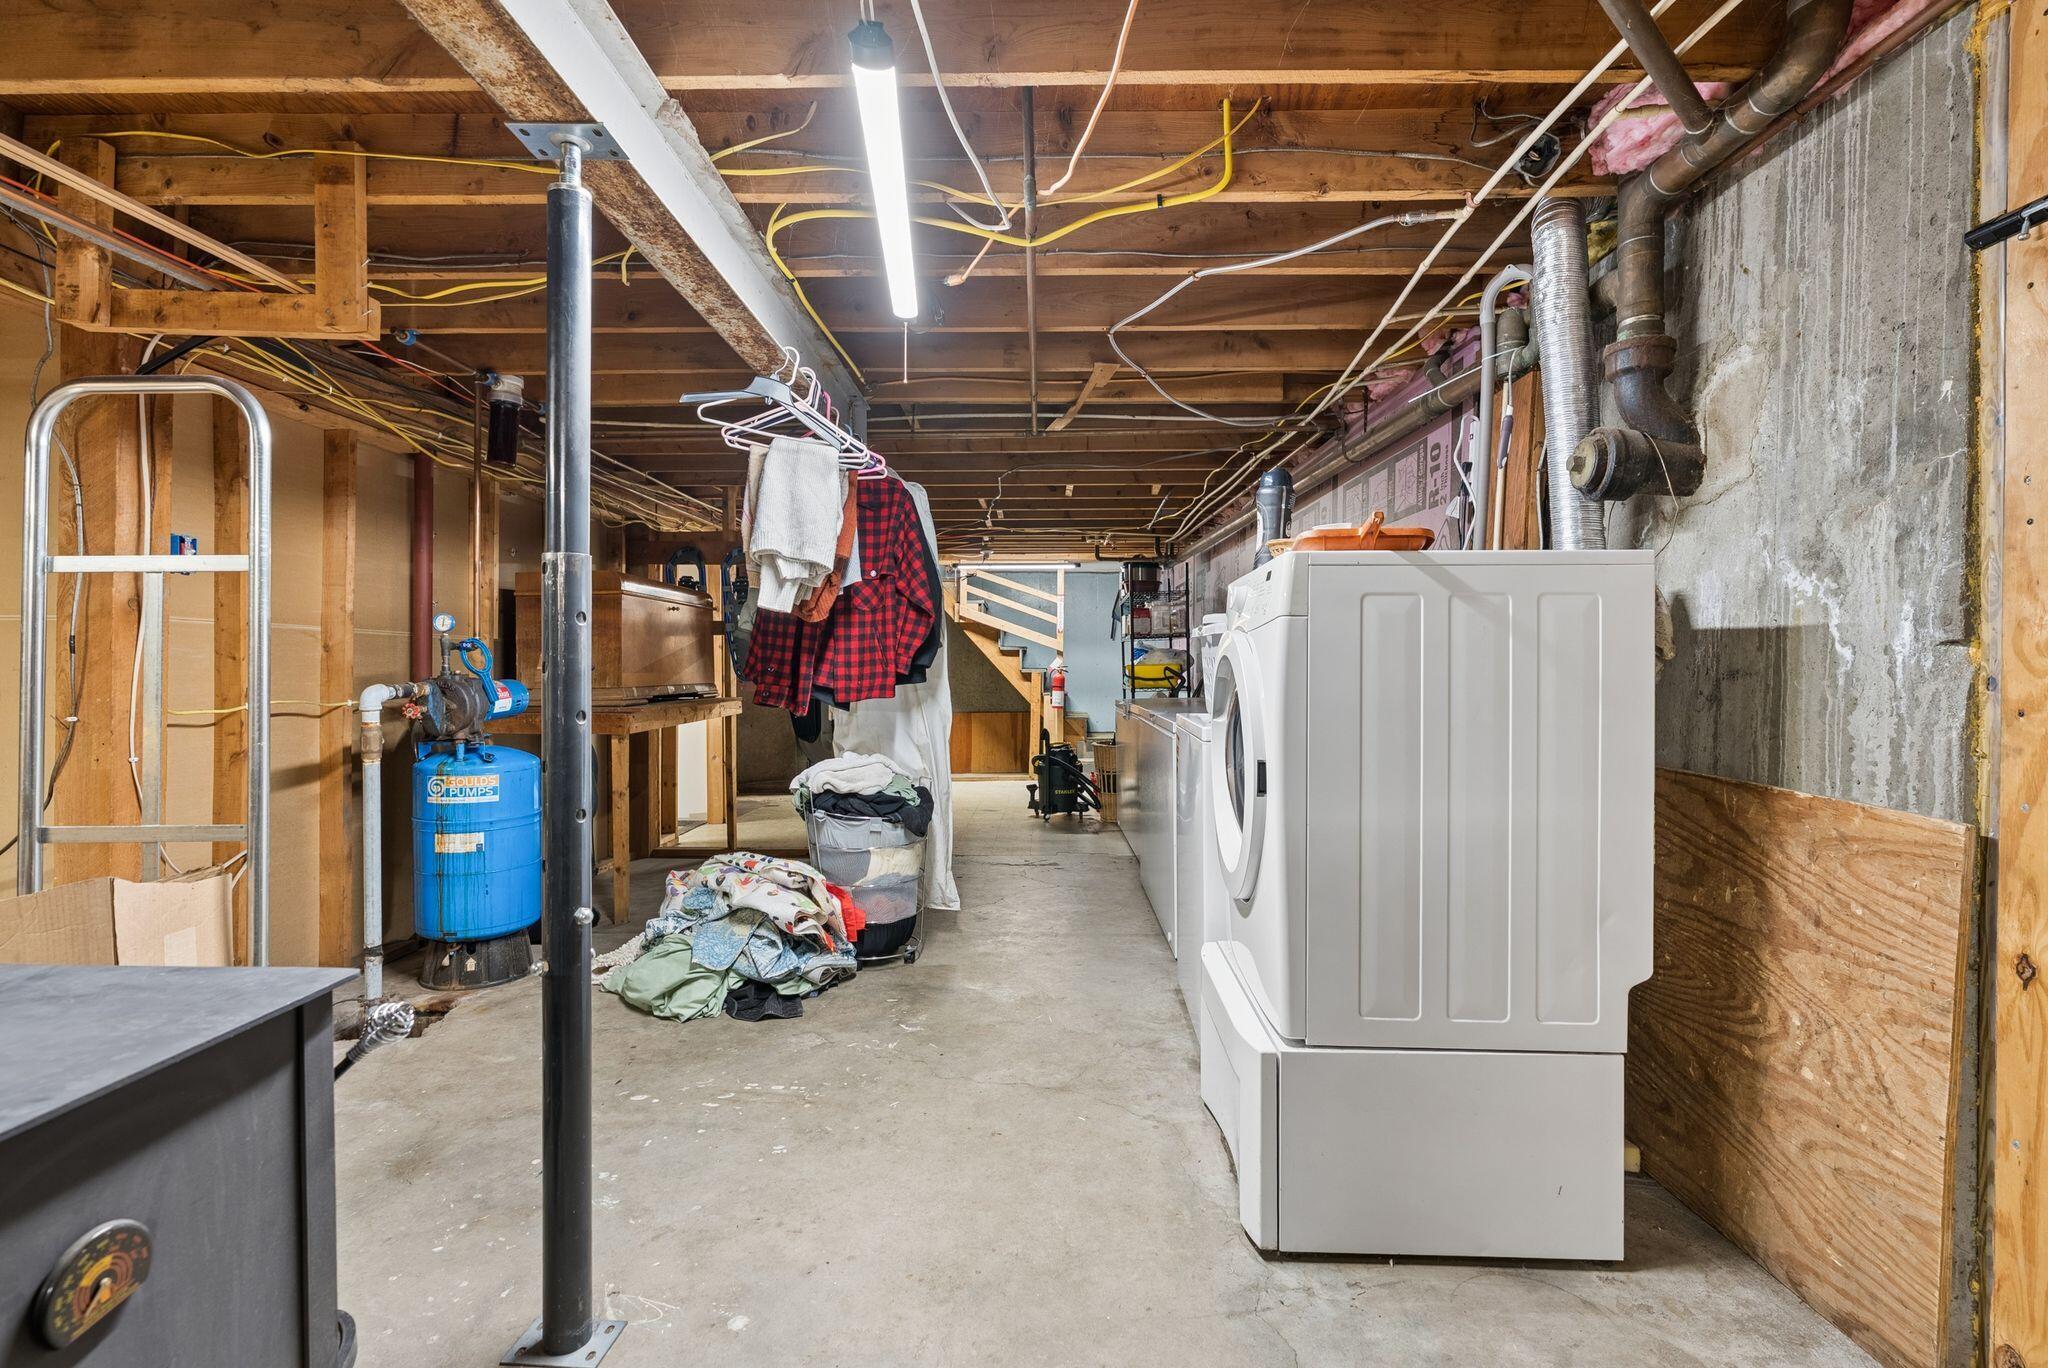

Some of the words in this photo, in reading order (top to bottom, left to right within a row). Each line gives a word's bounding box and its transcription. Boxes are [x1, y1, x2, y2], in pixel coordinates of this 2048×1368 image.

[1428, 442, 1441, 510] R-10
[1440, 494, 1447, 506] 2
[447, 776, 496, 786] GOULDS
[450, 786, 494, 797] PUMPS
